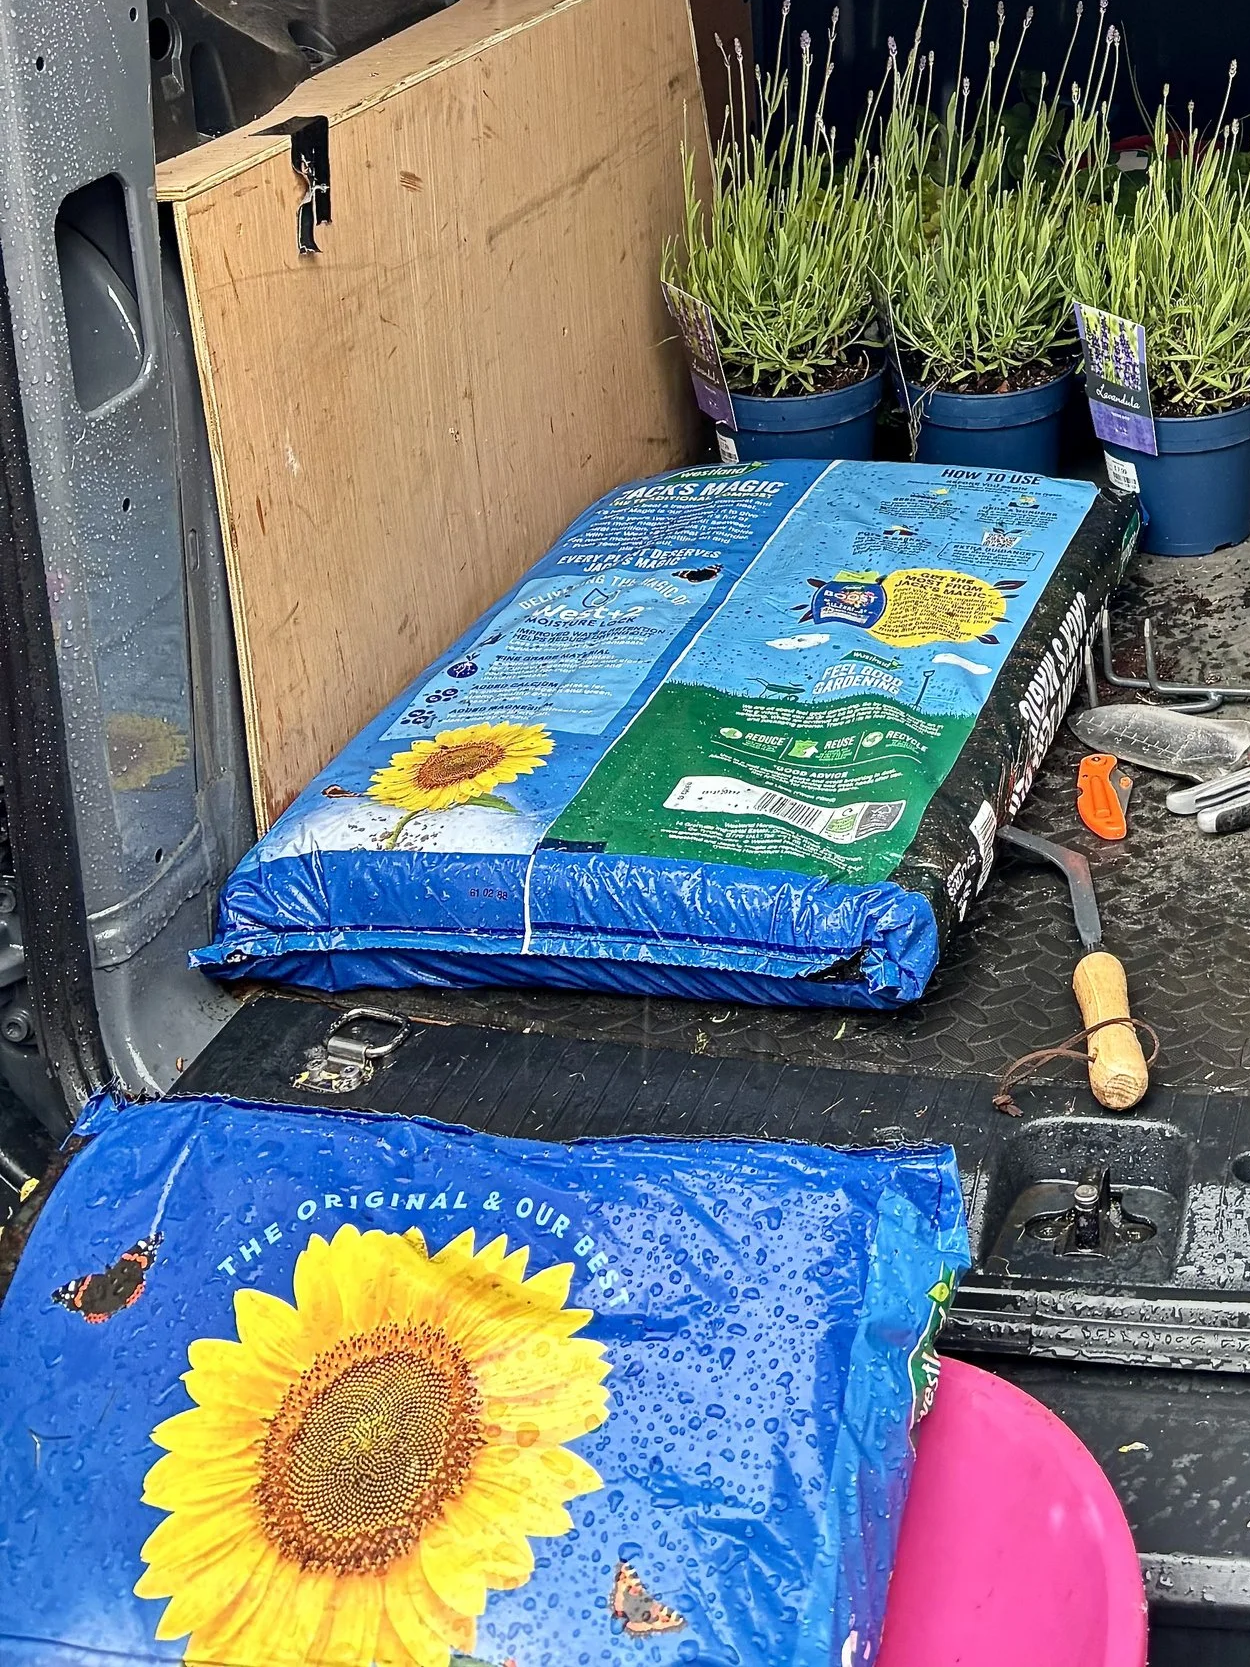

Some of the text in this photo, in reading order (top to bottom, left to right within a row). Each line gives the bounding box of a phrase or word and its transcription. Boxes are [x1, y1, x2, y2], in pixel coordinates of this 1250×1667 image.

[1096, 384, 1140, 409] Lavandula
[680, 465, 747, 479] westland
[940, 469, 1041, 485] HOW TO USE
[617, 479, 784, 500] JACK'S MAGIC
[556, 554, 604, 565] EVERY
[649, 549, 721, 559] DESERVES
[634, 558, 681, 571] MAGIC
[639, 577, 679, 599] MAGIC
[905, 574, 983, 592] MOST FROM
[921, 573, 975, 585] GET THE
[823, 590, 877, 604] BOOST
[895, 580, 988, 599] JACK'S MAGIC
[524, 616, 637, 627] MOISTURE LOCK
[1051, 591, 1088, 678] JACK'S
[821, 663, 904, 687] FEEL GOOD
[812, 675, 900, 696] GARDENING
[1018, 651, 1061, 739] MAGIC
[745, 733, 786, 746] REDUCE
[823, 736, 856, 750] REUSE
[886, 731, 928, 752] RECYCLE
[811, 770, 849, 779] ADVICE
[216, 1190, 630, 1309] THE ORIGINAL & OUR BEST
